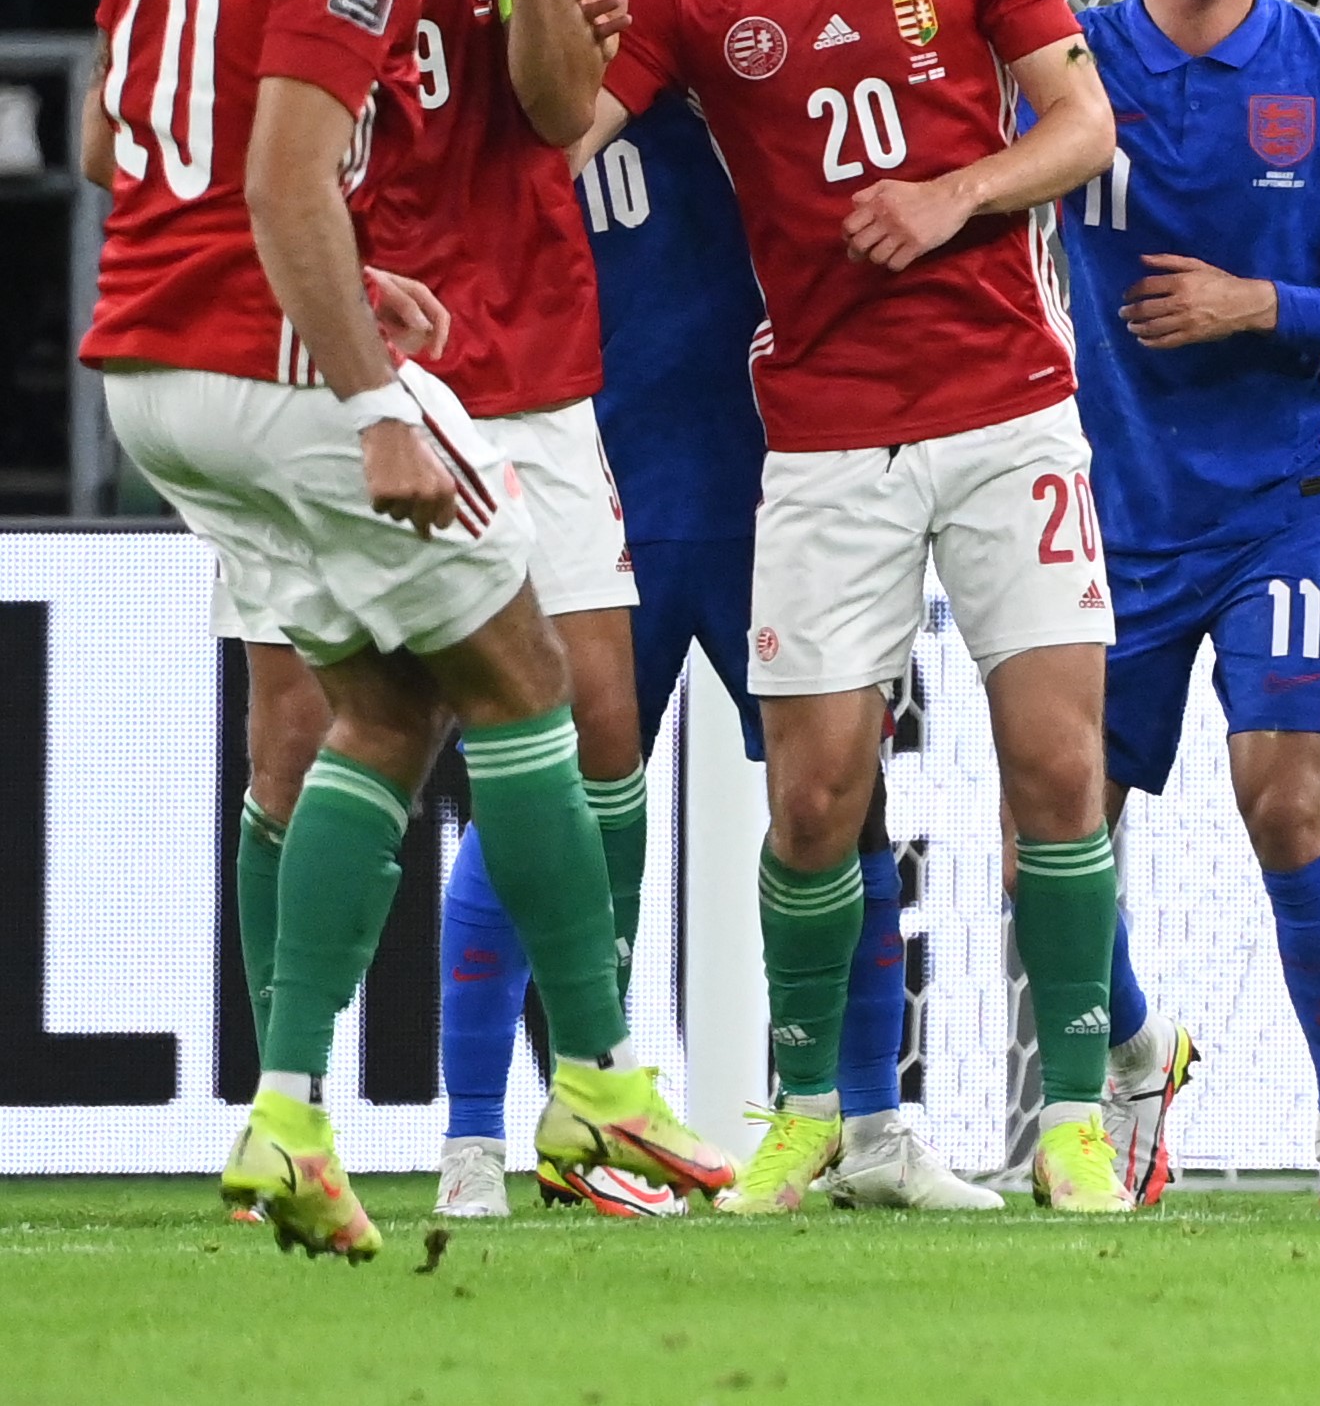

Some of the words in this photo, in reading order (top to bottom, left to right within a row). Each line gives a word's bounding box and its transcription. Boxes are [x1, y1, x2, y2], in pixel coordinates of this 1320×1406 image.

[414, 18, 451, 110] 9
[812, 31, 861, 51] adidas
[807, 77, 907, 183] 20
[581, 138, 651, 233] 10
[1083, 146, 1131, 232] 11
[1032, 471, 1097, 564] 20
